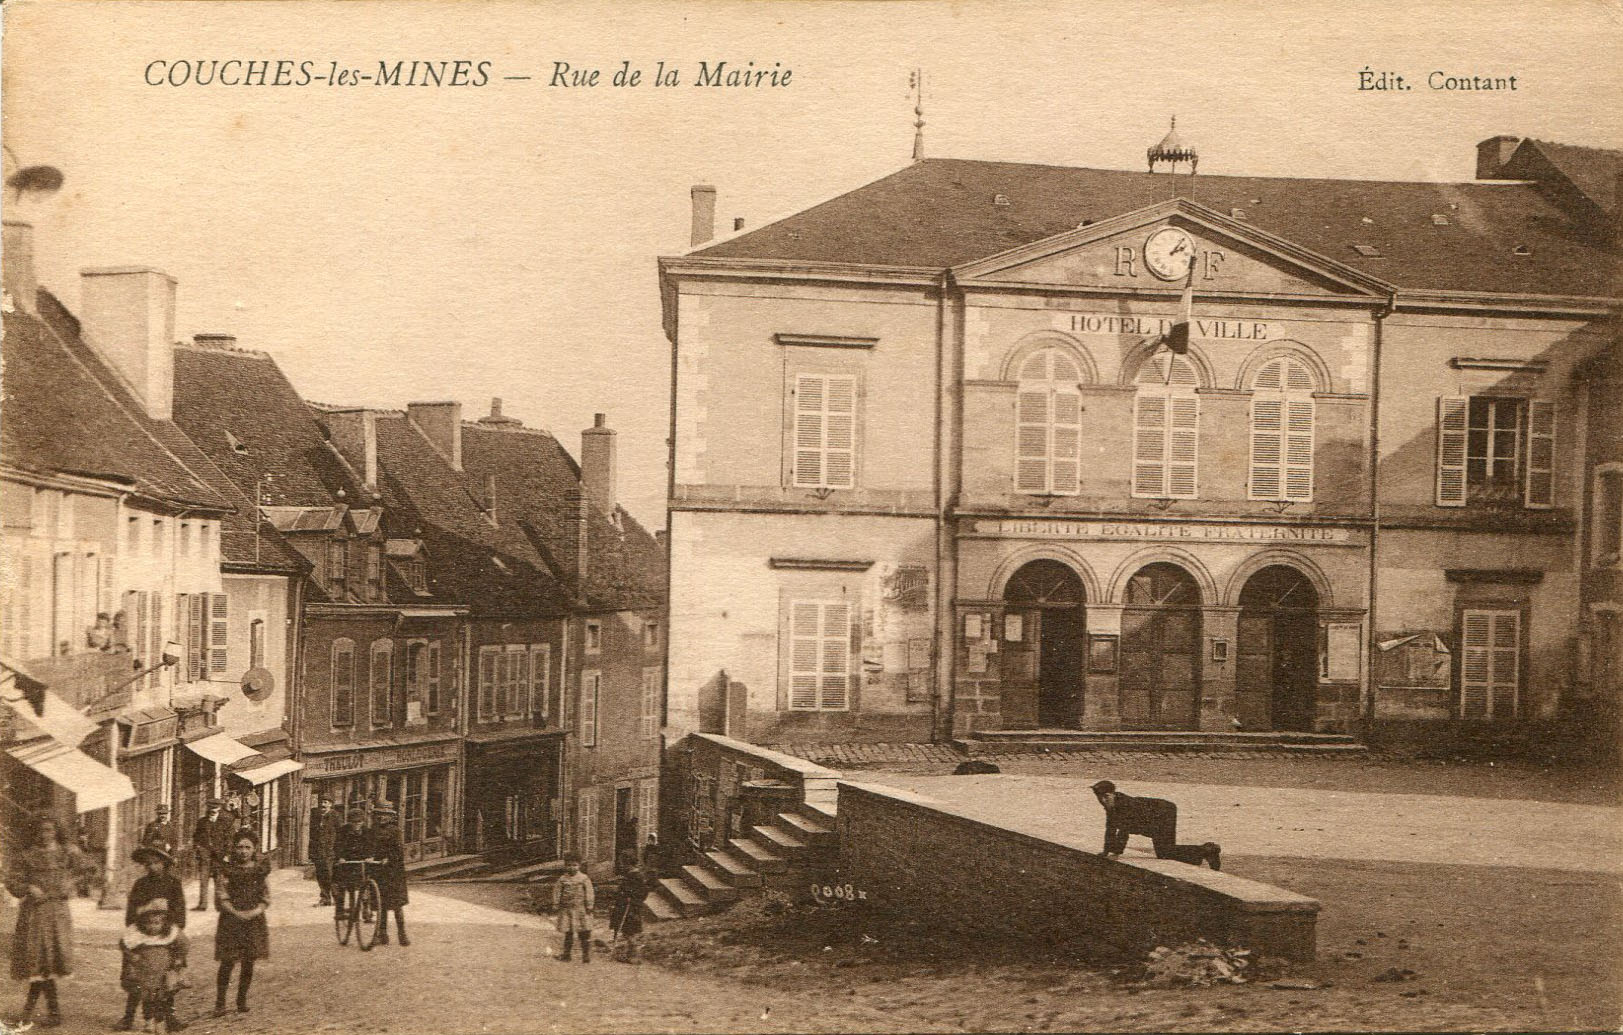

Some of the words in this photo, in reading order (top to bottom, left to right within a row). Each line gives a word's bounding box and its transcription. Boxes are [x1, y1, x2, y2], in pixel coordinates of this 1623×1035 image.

[1113, 247, 1137, 278] R
[1203, 251, 1225, 280] F
[1071, 315, 1150, 335] HOTEL
[1196, 320, 1267, 340] VILLE
